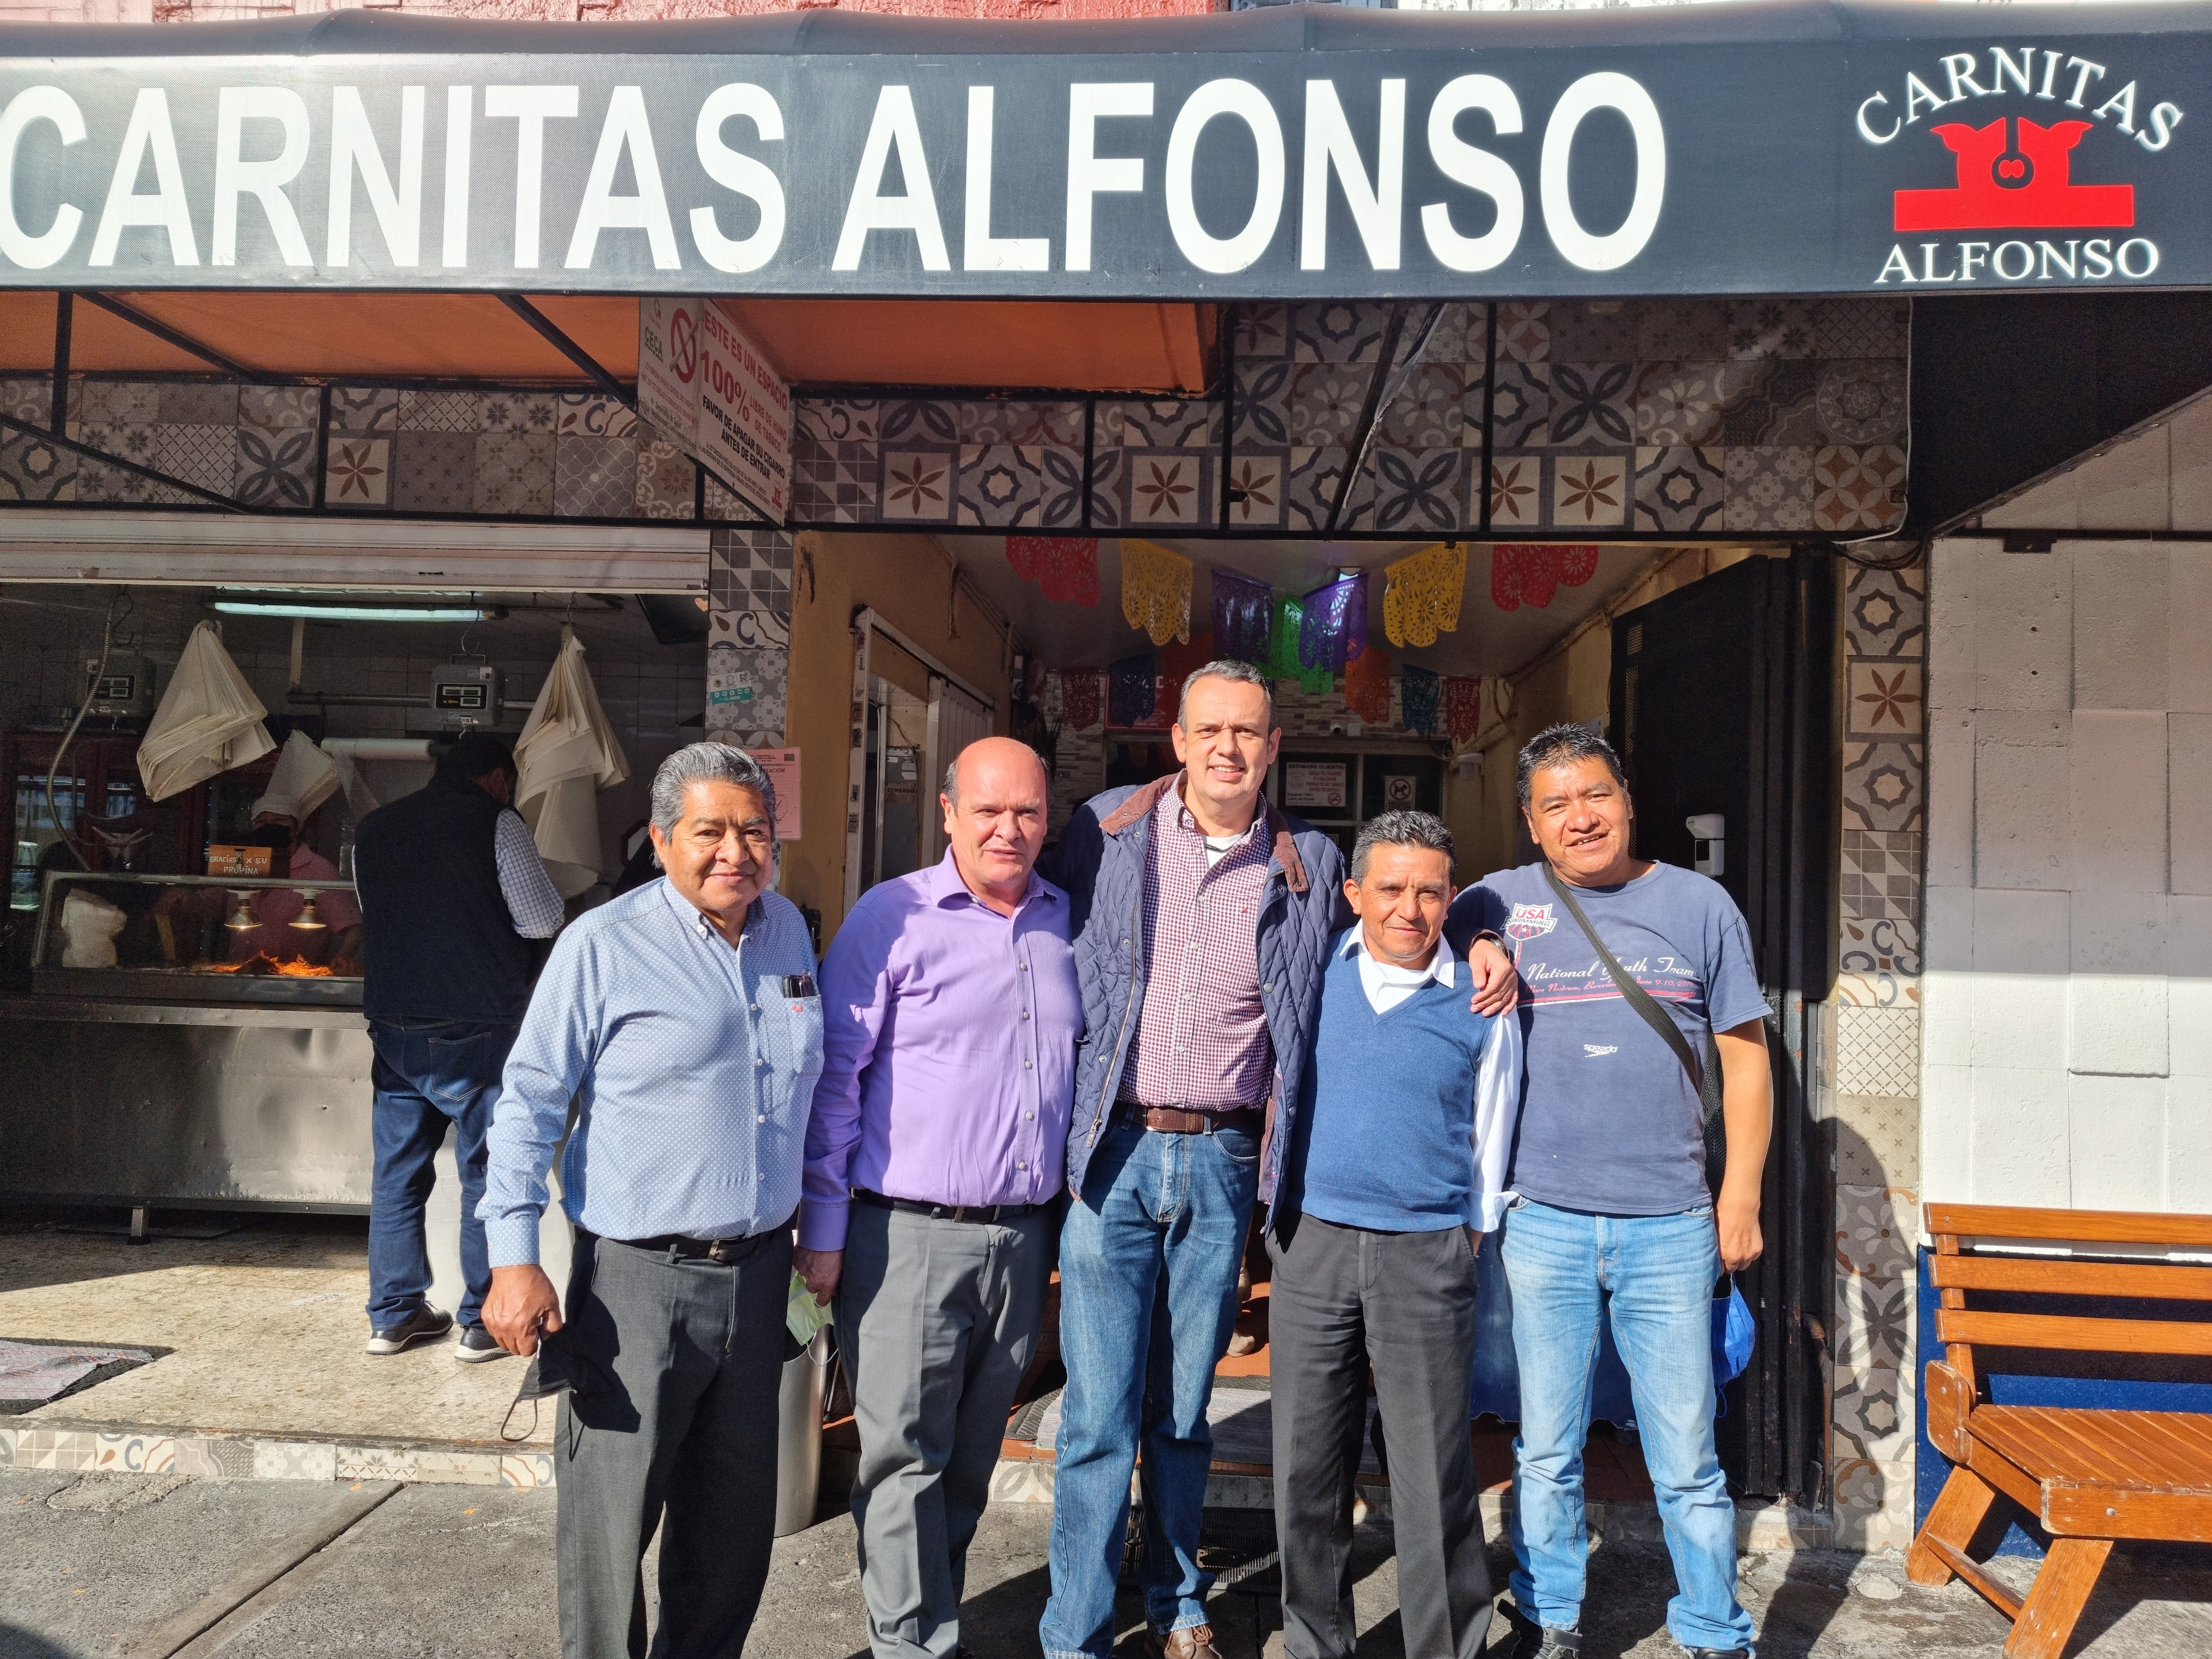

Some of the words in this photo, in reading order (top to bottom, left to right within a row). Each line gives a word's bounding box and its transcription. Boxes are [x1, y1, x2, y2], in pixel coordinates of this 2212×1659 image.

[1857, 47, 2184, 151] CARNITAS
[0, 82, 786, 273] CARNITAS
[832, 72, 1665, 273] ALFONSO
[1874, 239, 2159, 282] ALFONSO
[645, 326, 662, 357] CECA
[705, 310, 729, 350] ESTE
[731, 335, 741, 363] ES
[744, 350, 756, 378] UN
[758, 364, 787, 411] ESPACIO
[701, 349, 749, 421] 100%
[703, 394, 723, 423] FAVOR
[724, 414, 731, 431] DE
[733, 423, 755, 452] APAGAR
[756, 443, 763, 458] SU
[764, 451, 785, 478] CIGARRO
[750, 395, 764, 419] LIBRE
[766, 412, 772, 426] DE
[773, 420, 786, 441] HUMO
[755, 419, 761, 434] DE
[763, 426, 781, 453] TABACO
[721, 429, 740, 454] ANTES
[741, 445, 749, 462] DE
[750, 453, 770, 480] ENTRAR
[1507, 918, 1551, 927] SWIMMING
[1516, 908, 1545, 920] USA
[1525, 984, 1545, 994] Mare
[1548, 982, 1581, 992] Nostrum,
[1584, 979, 1617, 990] Barcelon
[1636, 975, 1653, 985] June
[1527, 960, 1600, 980] National
[1600, 957, 1648, 980] Yuth
[1653, 957, 1694, 977] Team
[1584, 1044, 1618, 1053] speedo
